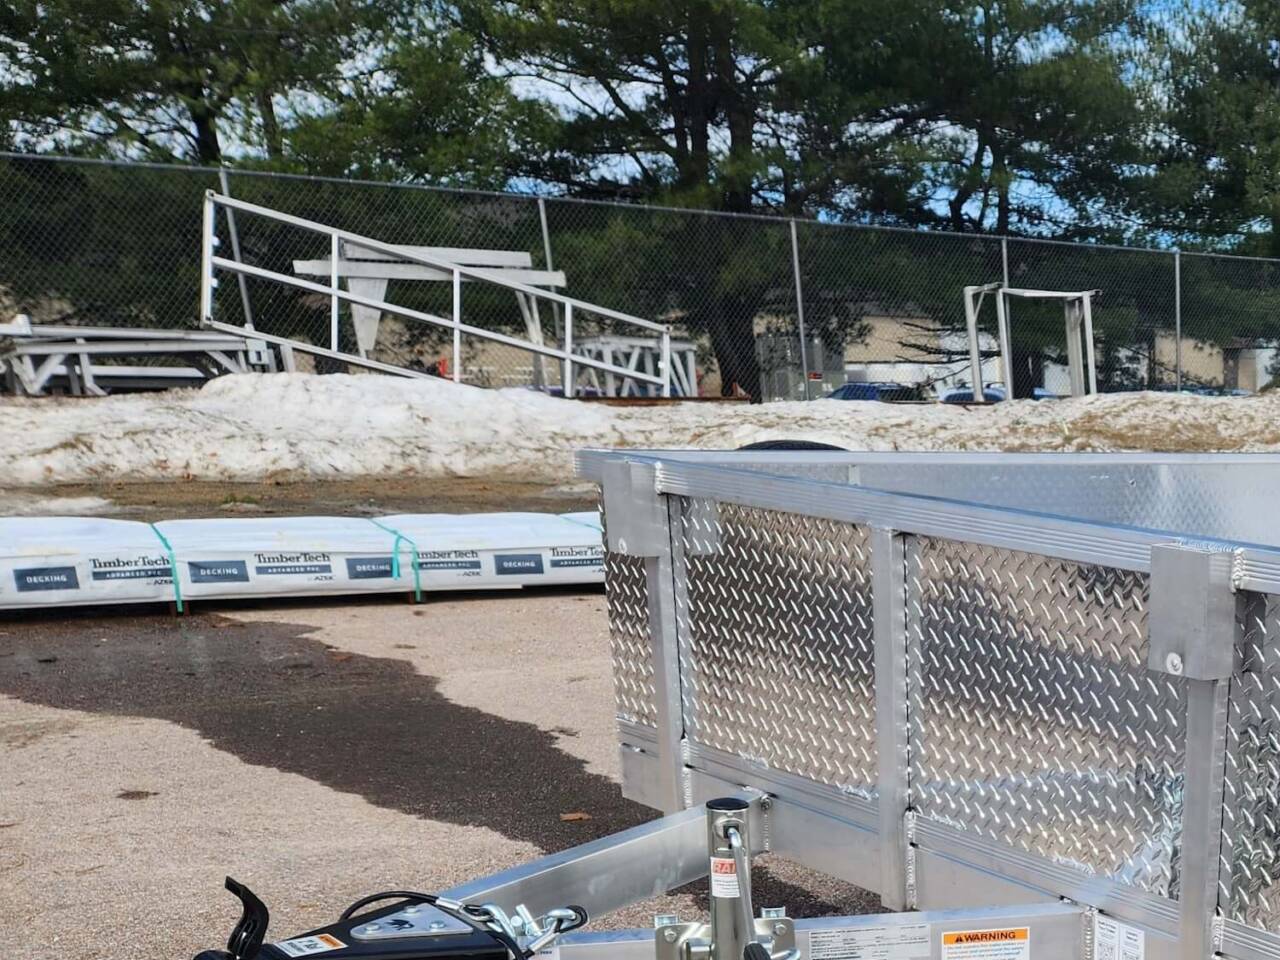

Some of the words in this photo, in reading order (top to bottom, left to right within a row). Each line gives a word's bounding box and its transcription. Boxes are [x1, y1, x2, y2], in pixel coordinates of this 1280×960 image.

[254, 552, 331, 564] TimberTech
[416, 550, 479, 560] imberTech
[89, 556, 170, 569] TimberTech
[200, 568, 238, 576] DECKING
[355, 564, 391, 572] DECKING
[26, 574, 67, 584] DECKING
[964, 931, 1016, 942] WARNING
